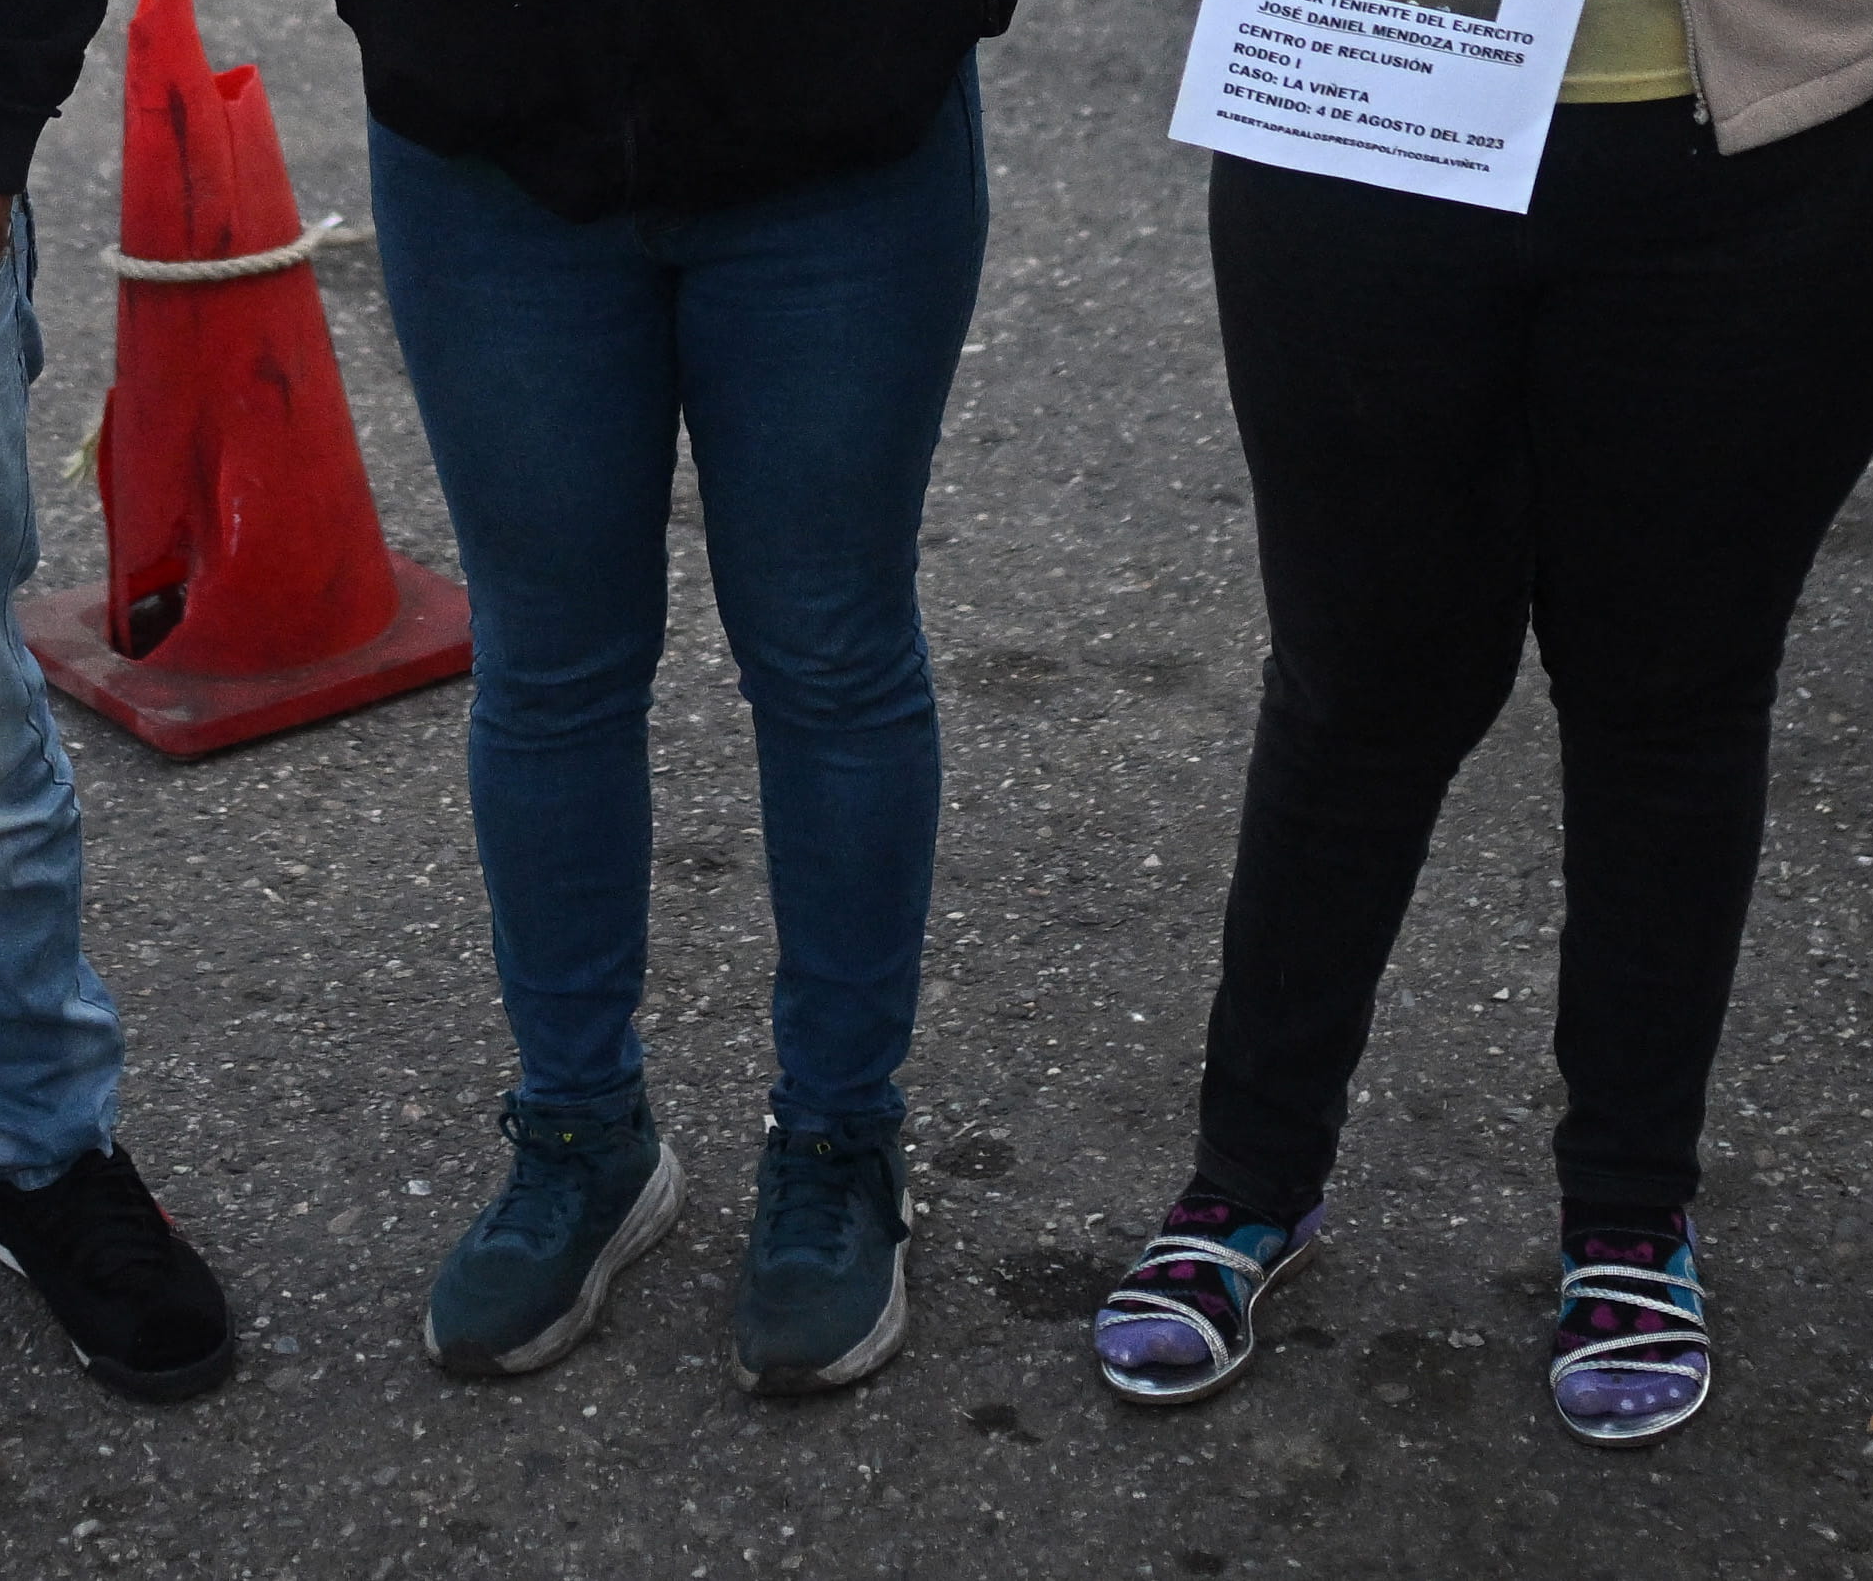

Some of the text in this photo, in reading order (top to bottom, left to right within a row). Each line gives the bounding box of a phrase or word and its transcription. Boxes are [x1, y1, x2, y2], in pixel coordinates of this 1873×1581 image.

[1239, 23, 1434, 74] CENTRO DE RECLUSIÓN
[1259, 0, 1525, 64] JOSÉ DANIEL MENDOZA TORRES
[1416, 12, 1446, 28] DEL
[1452, 19, 1534, 45] EJERCITO
[1233, 42, 1301, 69] RODEO I
[1229, 62, 1370, 103] CASO: LA VIÑETA
[1223, 82, 1505, 150] DETENIDO: 4 DE AGOSTO DEL 2023
